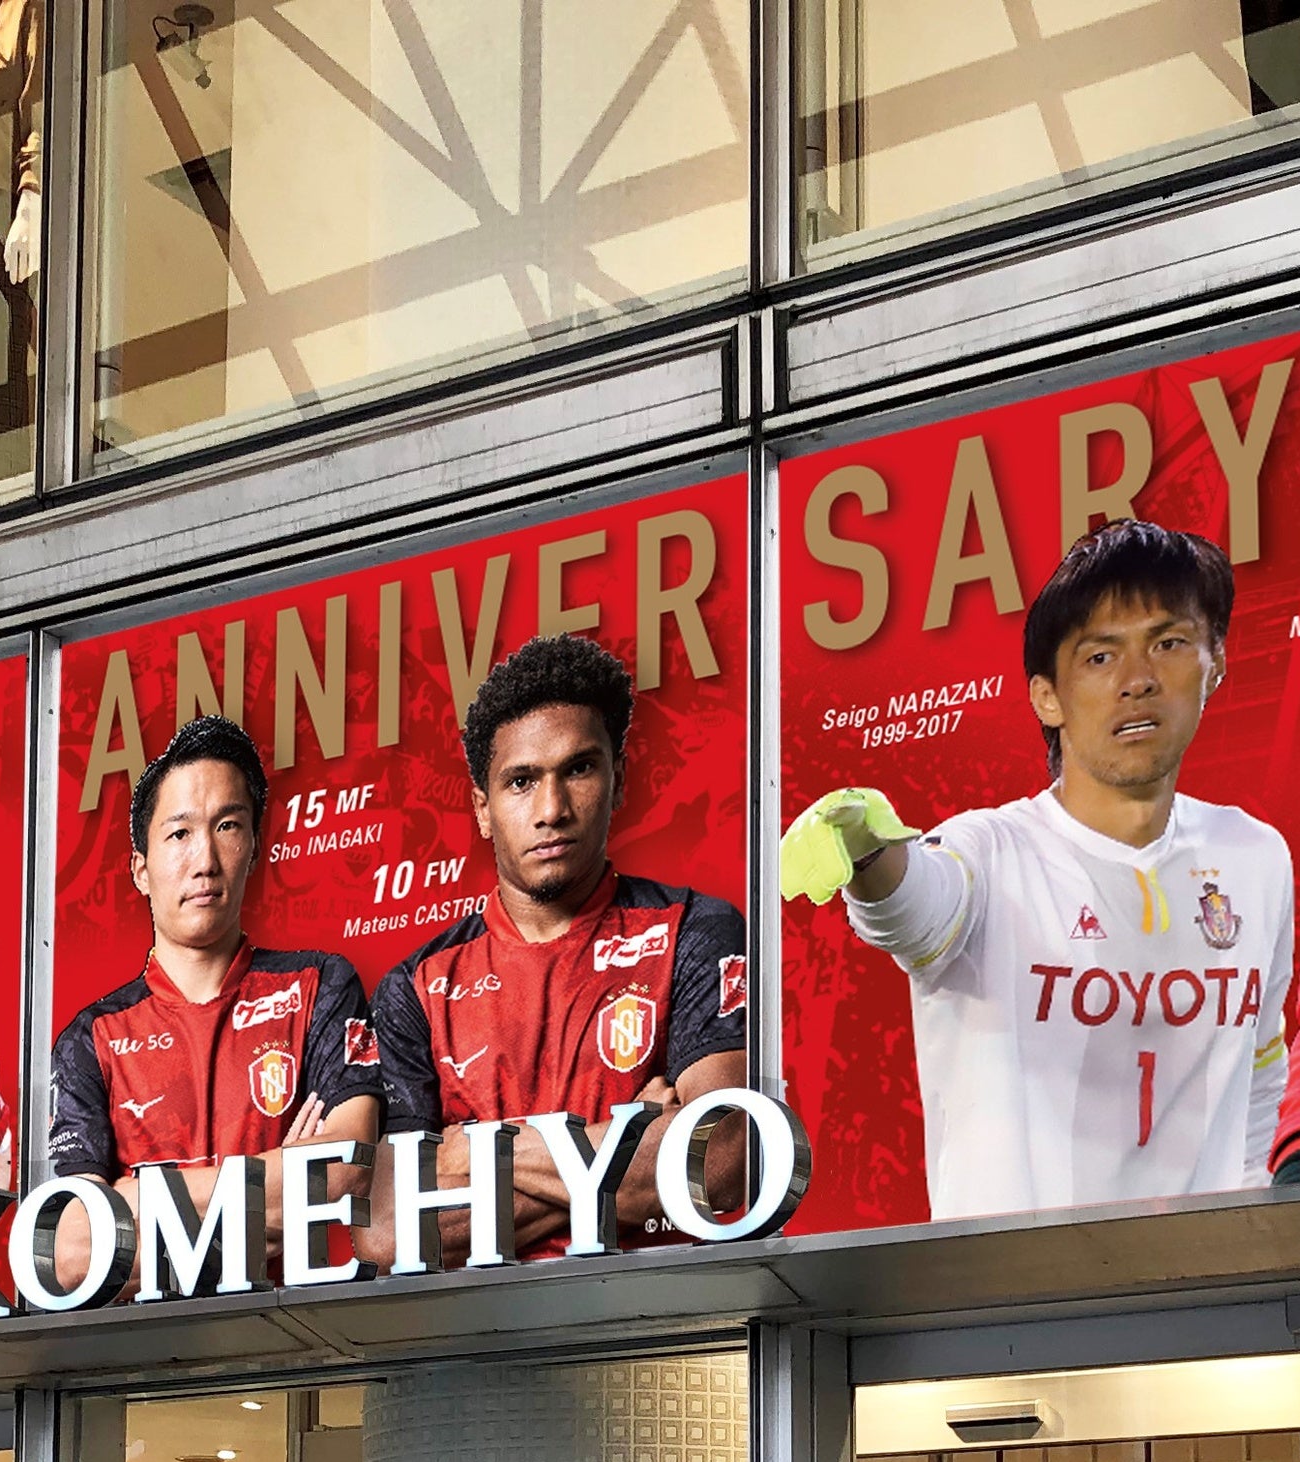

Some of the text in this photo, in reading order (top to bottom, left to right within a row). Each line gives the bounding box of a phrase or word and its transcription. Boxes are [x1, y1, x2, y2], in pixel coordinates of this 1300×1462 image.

[822, 675, 1004, 730] Seigo NARAZAKI
[862, 710, 963, 749] 1999-2017
[286, 783, 375, 834] 15 MF
[269, 823, 383, 863] Sho INAGAKI
[372, 856, 467, 904] 10 FW
[343, 894, 488, 939] Mateus CASTRO
[471, 974, 501, 999] 5G
[1030, 964, 1261, 1028] TOYOTA
[147, 1032, 174, 1051] 5G
[1138, 1051, 1156, 1148] 1
